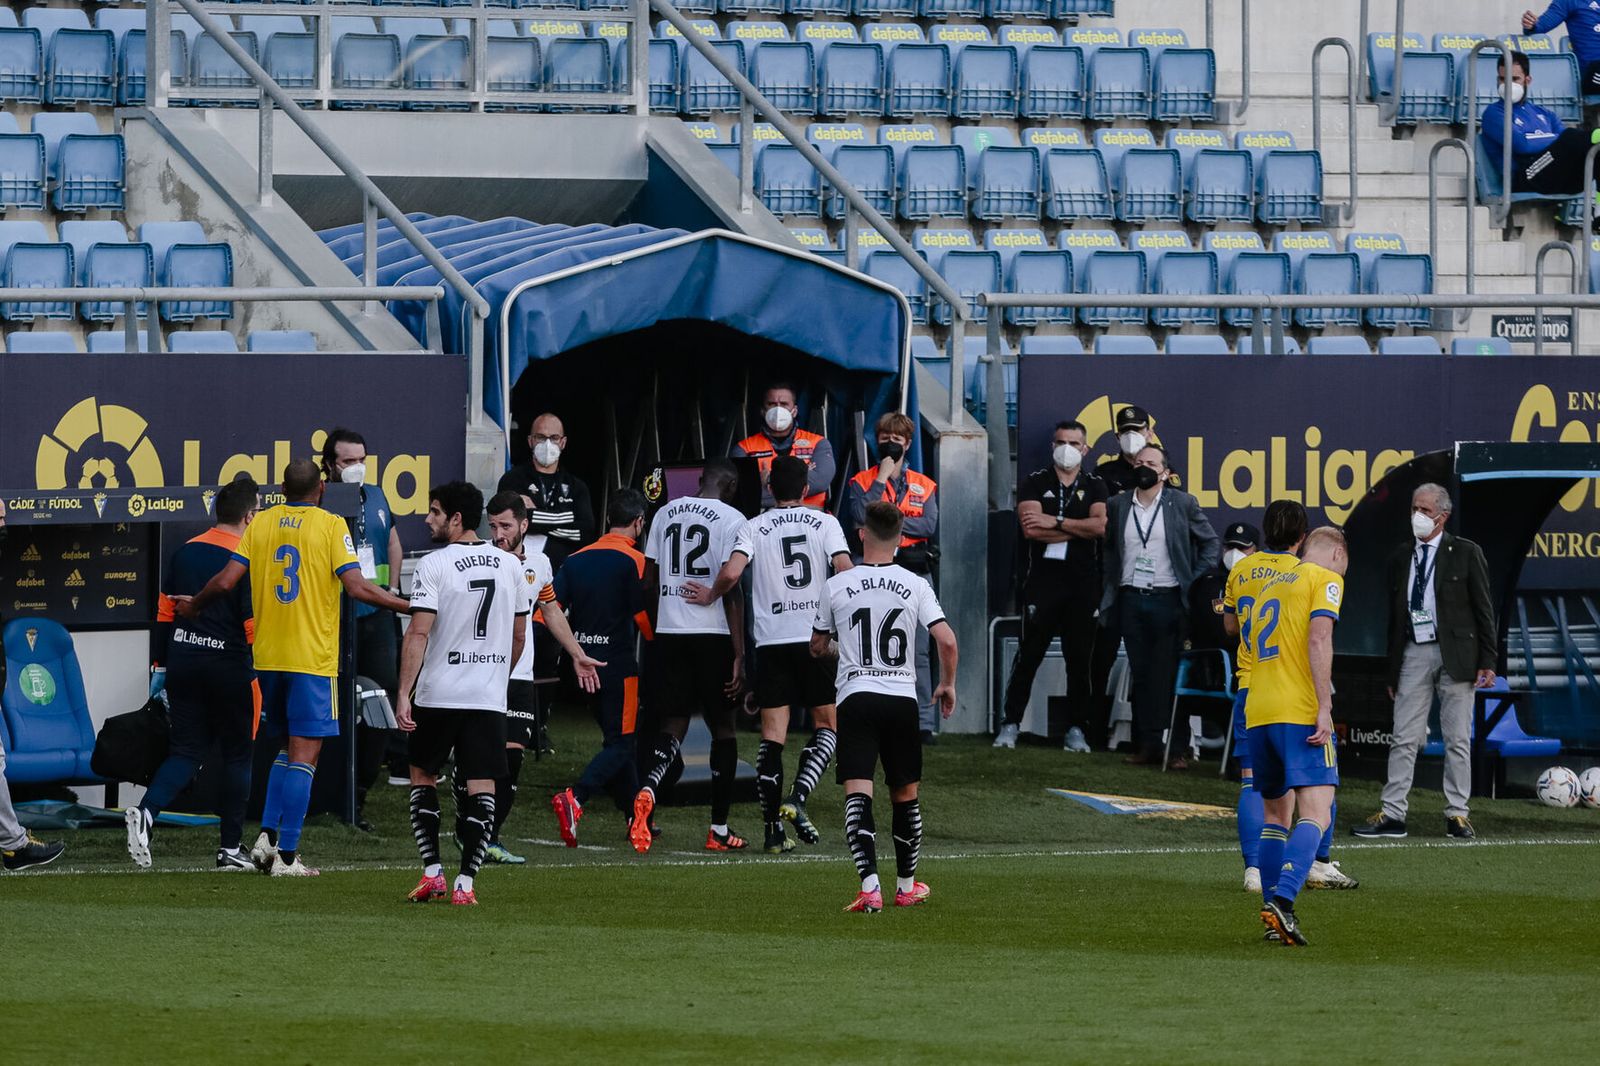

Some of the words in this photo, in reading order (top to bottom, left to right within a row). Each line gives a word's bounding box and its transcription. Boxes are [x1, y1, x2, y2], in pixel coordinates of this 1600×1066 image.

[530, 21, 580, 35] dafabet
[666, 22, 717, 37] dabet
[736, 25, 785, 39] dafabet
[805, 26, 853, 40] dafabet
[871, 27, 920, 40] dafabet
[938, 29, 987, 42] dafabet
[1007, 30, 1054, 43] dafabet
[1072, 31, 1120, 44] dafabet
[1137, 31, 1184, 46] dafabet
[814, 127, 864, 142] dafabet
[886, 128, 936, 142] dafabet
[1031, 130, 1080, 145] dafabet
[1102, 133, 1150, 146] dafabet
[1174, 133, 1222, 146] dafabet
[1243, 134, 1292, 148] dafabet
[922, 232, 970, 246] dafabet
[993, 233, 1041, 247] dafabet
[1067, 235, 1115, 247] dafabet
[1138, 235, 1186, 248] dafabet
[1211, 236, 1259, 250] dafabet
[1282, 236, 1329, 249] dafabet
[1354, 237, 1402, 250] dafabet
[1568, 391, 1600, 411] EN
[184, 429, 430, 515] LaLia
[9, 497, 35, 510] CÁDIZ
[49, 496, 83, 509] FÚTBOL
[147, 497, 184, 511] LaLiga
[667, 503, 721, 523] DIAKHABY
[279, 516, 304, 529] FALI
[759, 525, 772, 536] G.
[772, 513, 823, 531] PAULISTA
[664, 522, 711, 578] 12
[1526, 533, 1600, 558] NERG
[454, 554, 501, 572] GUEDES
[779, 533, 812, 590] 5
[273, 543, 302, 605] 3
[846, 586, 860, 598] A.
[861, 577, 912, 600] BLANCO
[467, 578, 496, 640] 7
[849, 606, 908, 668] 16
[1256, 598, 1280, 662] 2
[183, 630, 225, 650] Libertex
